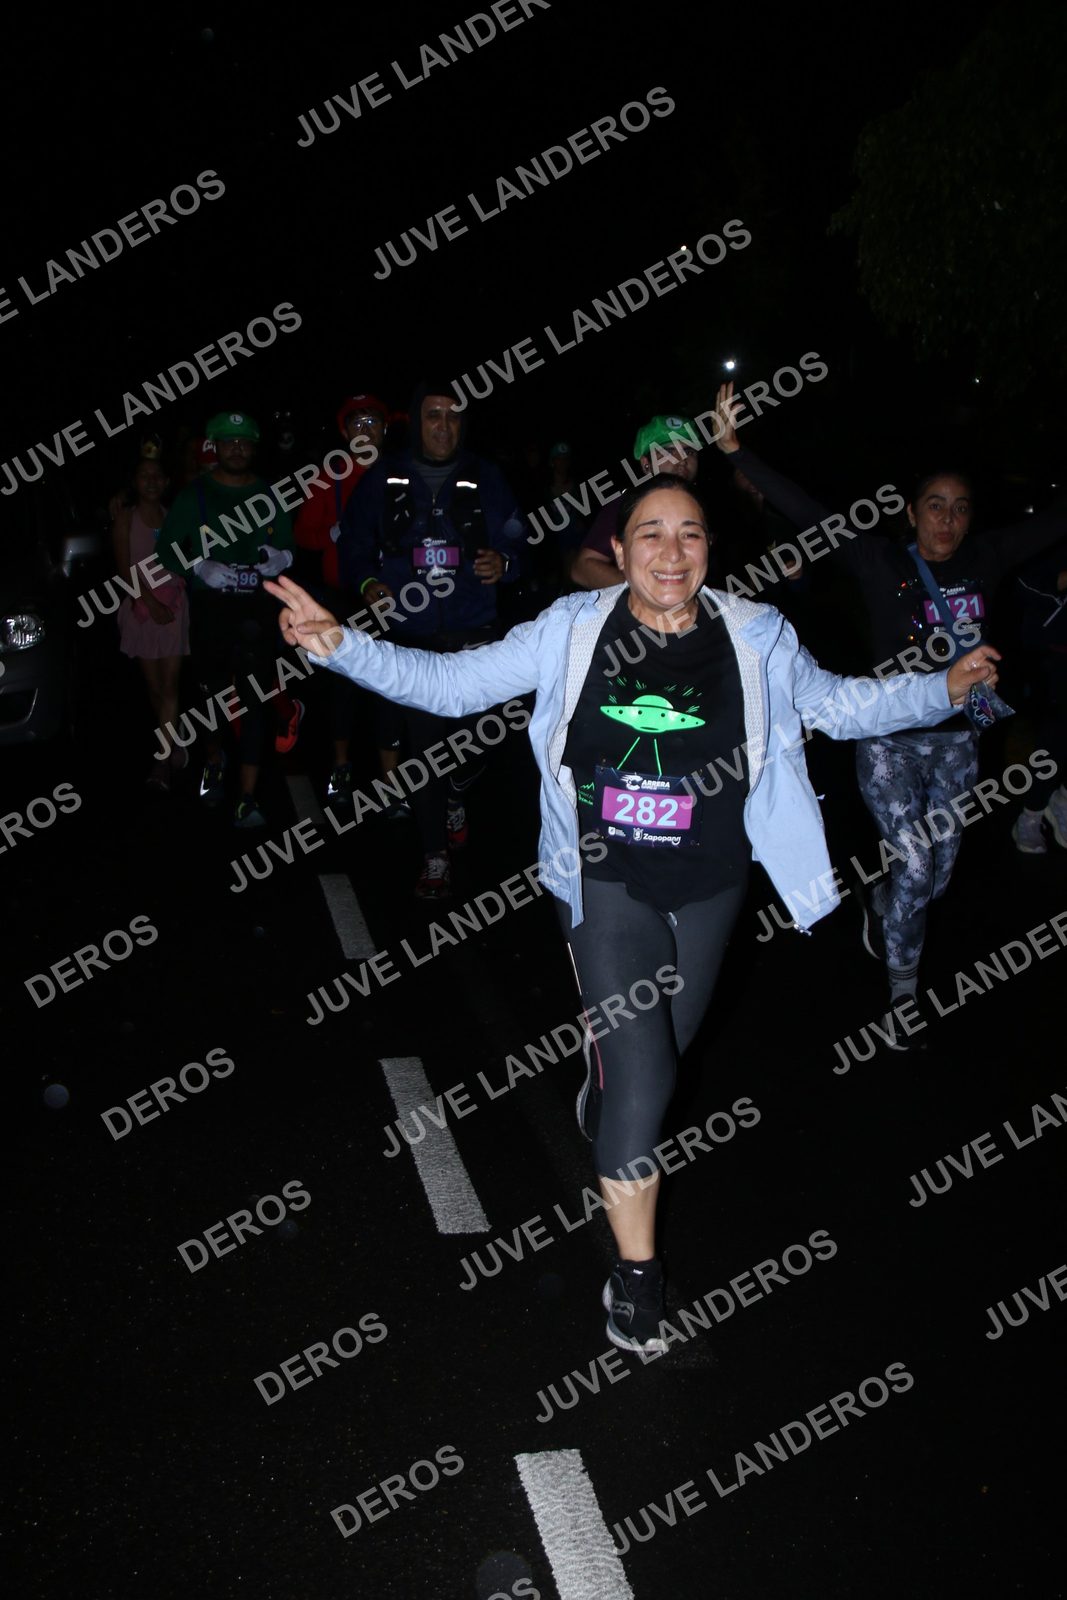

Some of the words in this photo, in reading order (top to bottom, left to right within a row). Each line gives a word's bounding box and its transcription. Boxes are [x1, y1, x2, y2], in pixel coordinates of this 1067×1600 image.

[425, 549, 447, 565] 80
[929, 595, 980, 621] 121
[614, 793, 678, 827] 282
